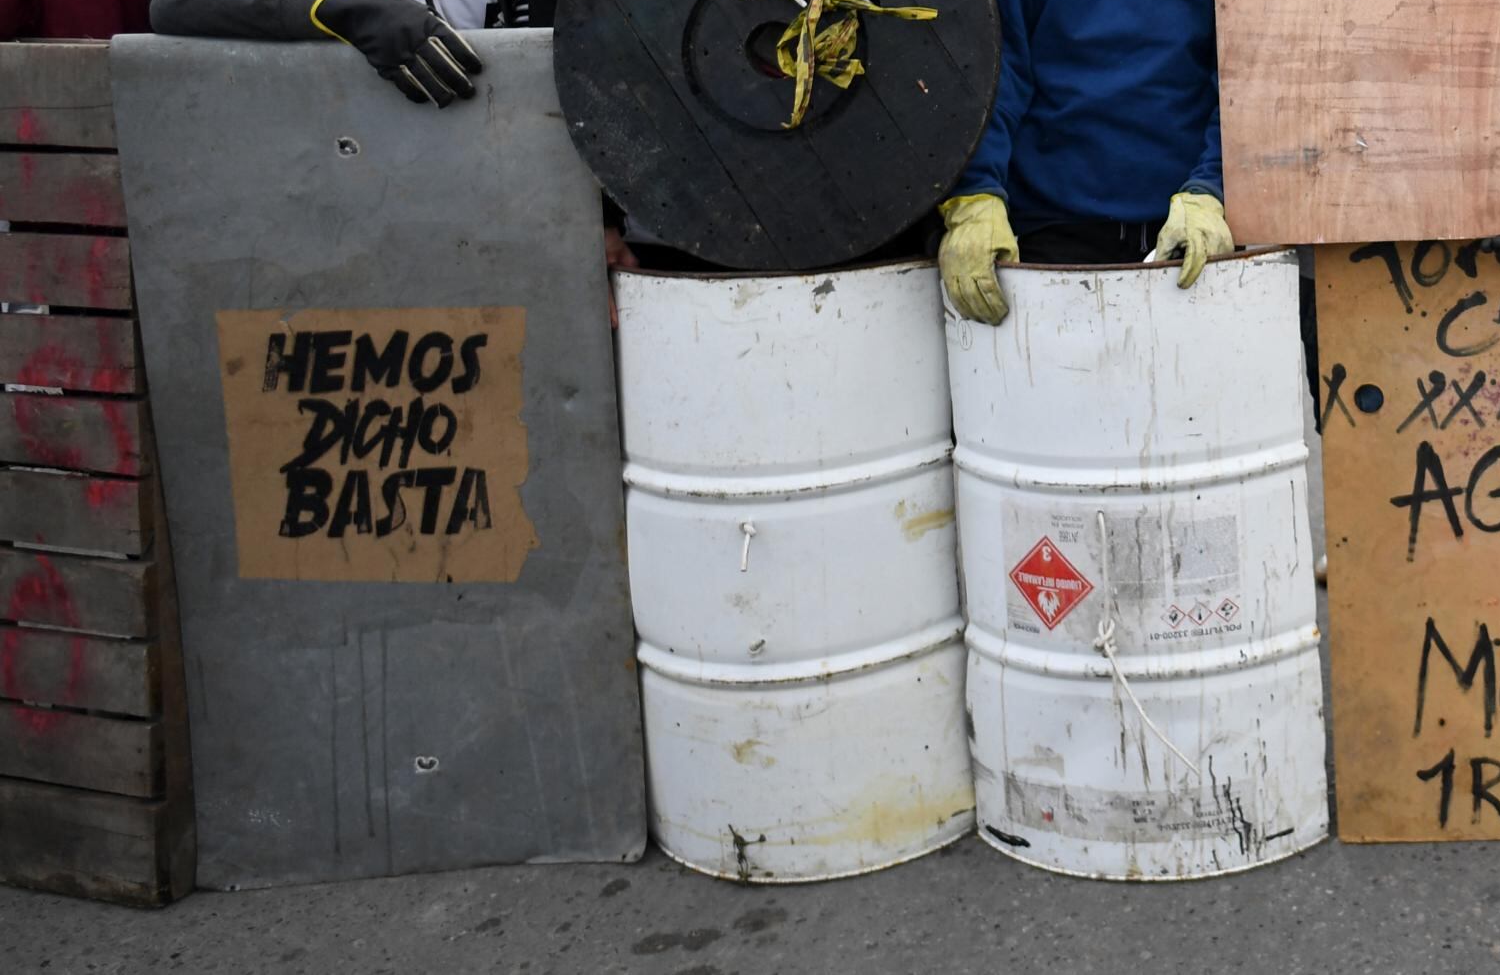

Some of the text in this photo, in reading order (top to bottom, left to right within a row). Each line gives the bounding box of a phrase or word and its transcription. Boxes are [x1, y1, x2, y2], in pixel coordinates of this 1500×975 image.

[262, 330, 489, 394] HEMOS
[279, 396, 458, 474] DICHO
[278, 466, 492, 538] BASTA
[1042, 545, 1053, 562] 3
